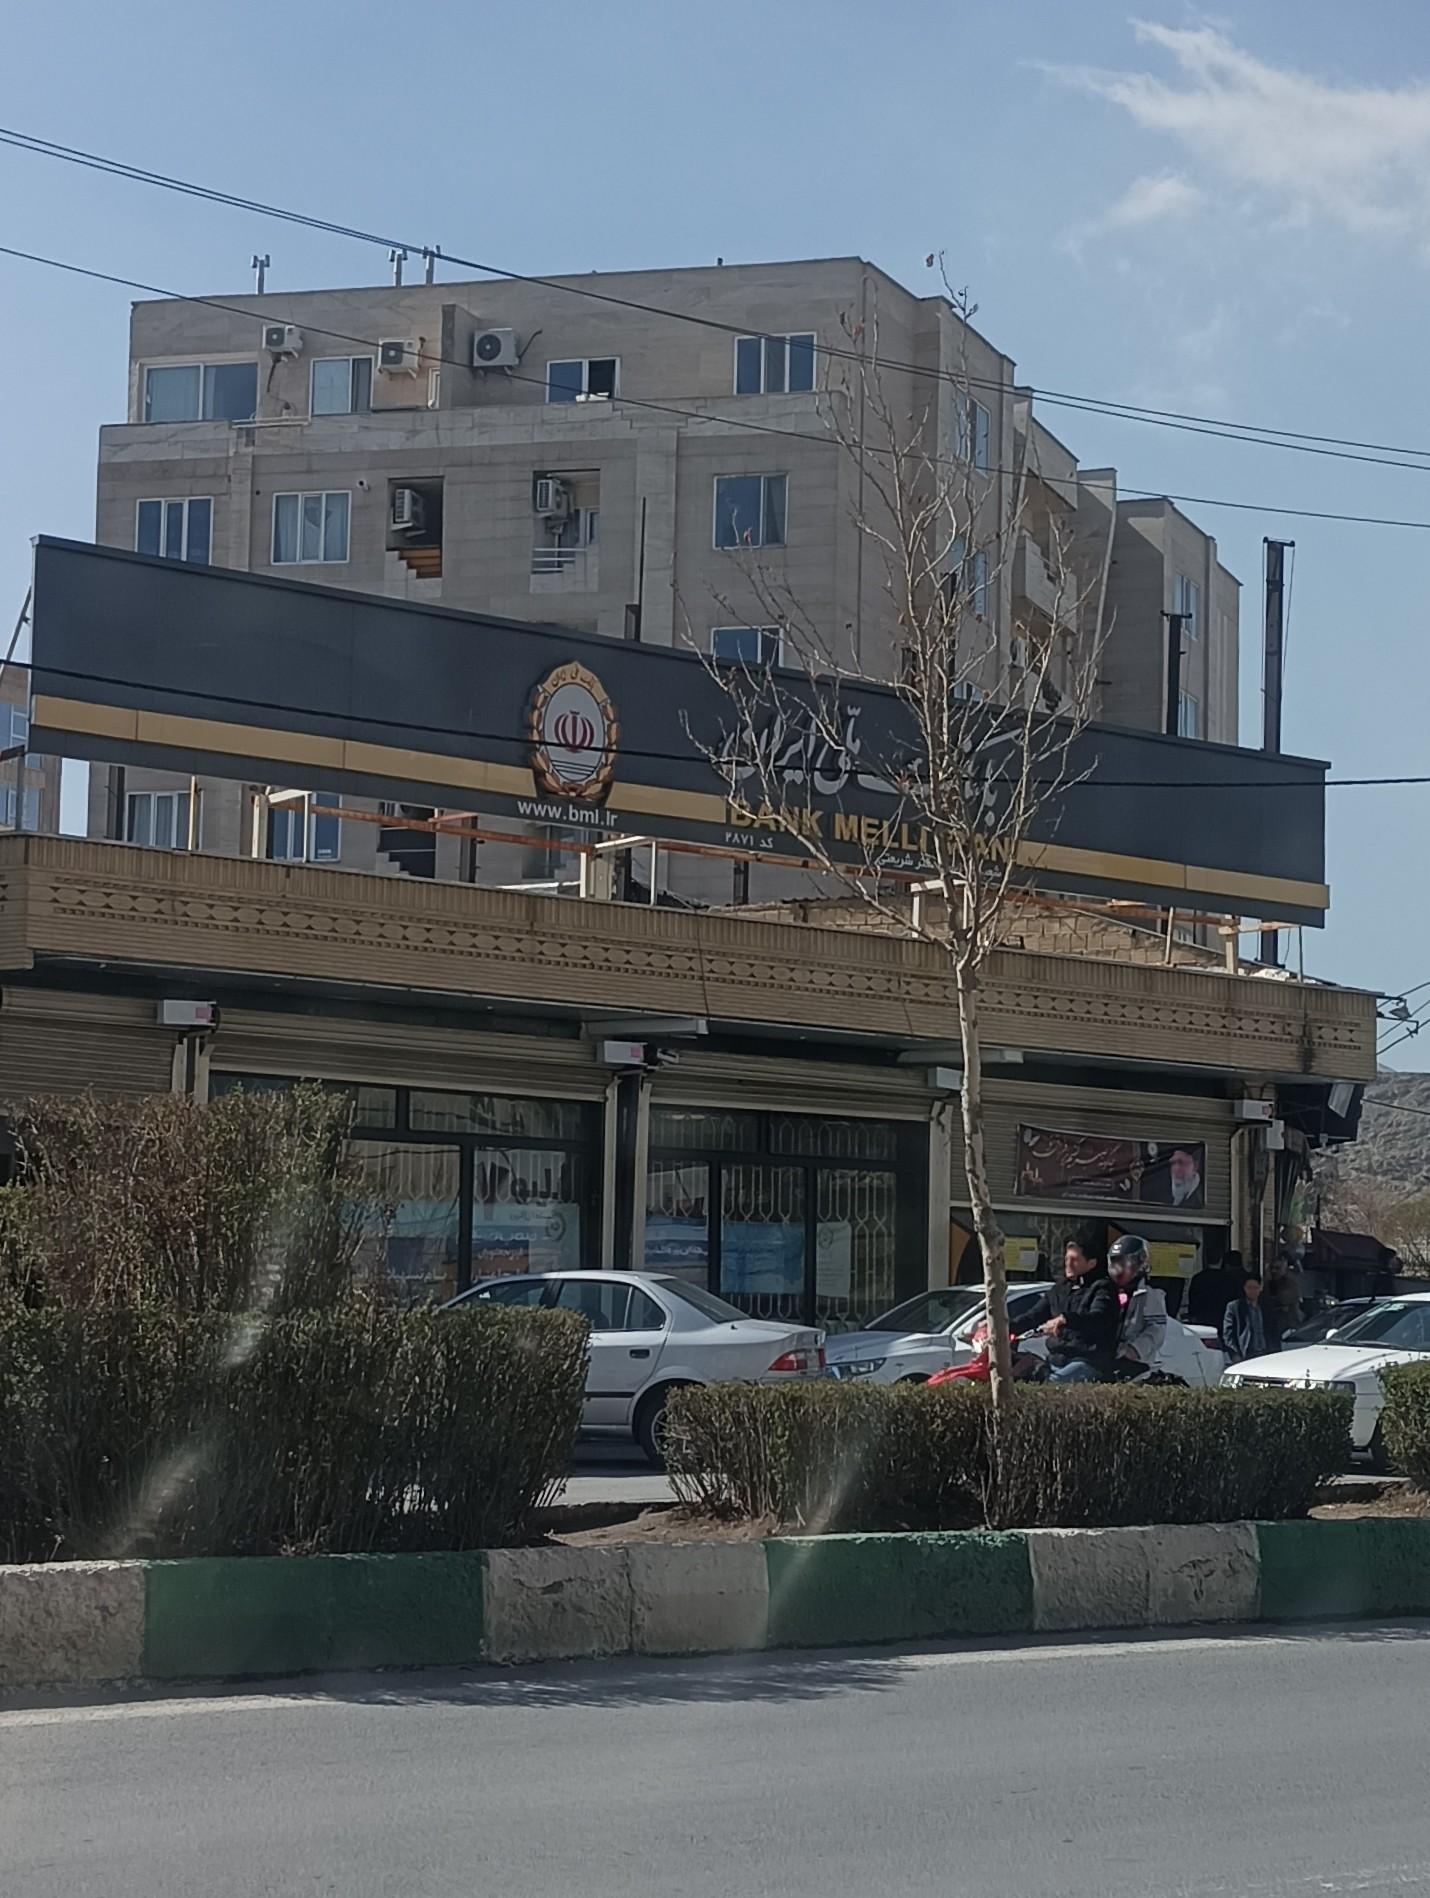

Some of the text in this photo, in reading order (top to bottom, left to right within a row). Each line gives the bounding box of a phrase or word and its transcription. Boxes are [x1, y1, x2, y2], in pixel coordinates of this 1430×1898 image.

[729, 798, 824, 838] BANK
[833, 812, 928, 852] MELLI
[759, 836, 774, 850] کد
